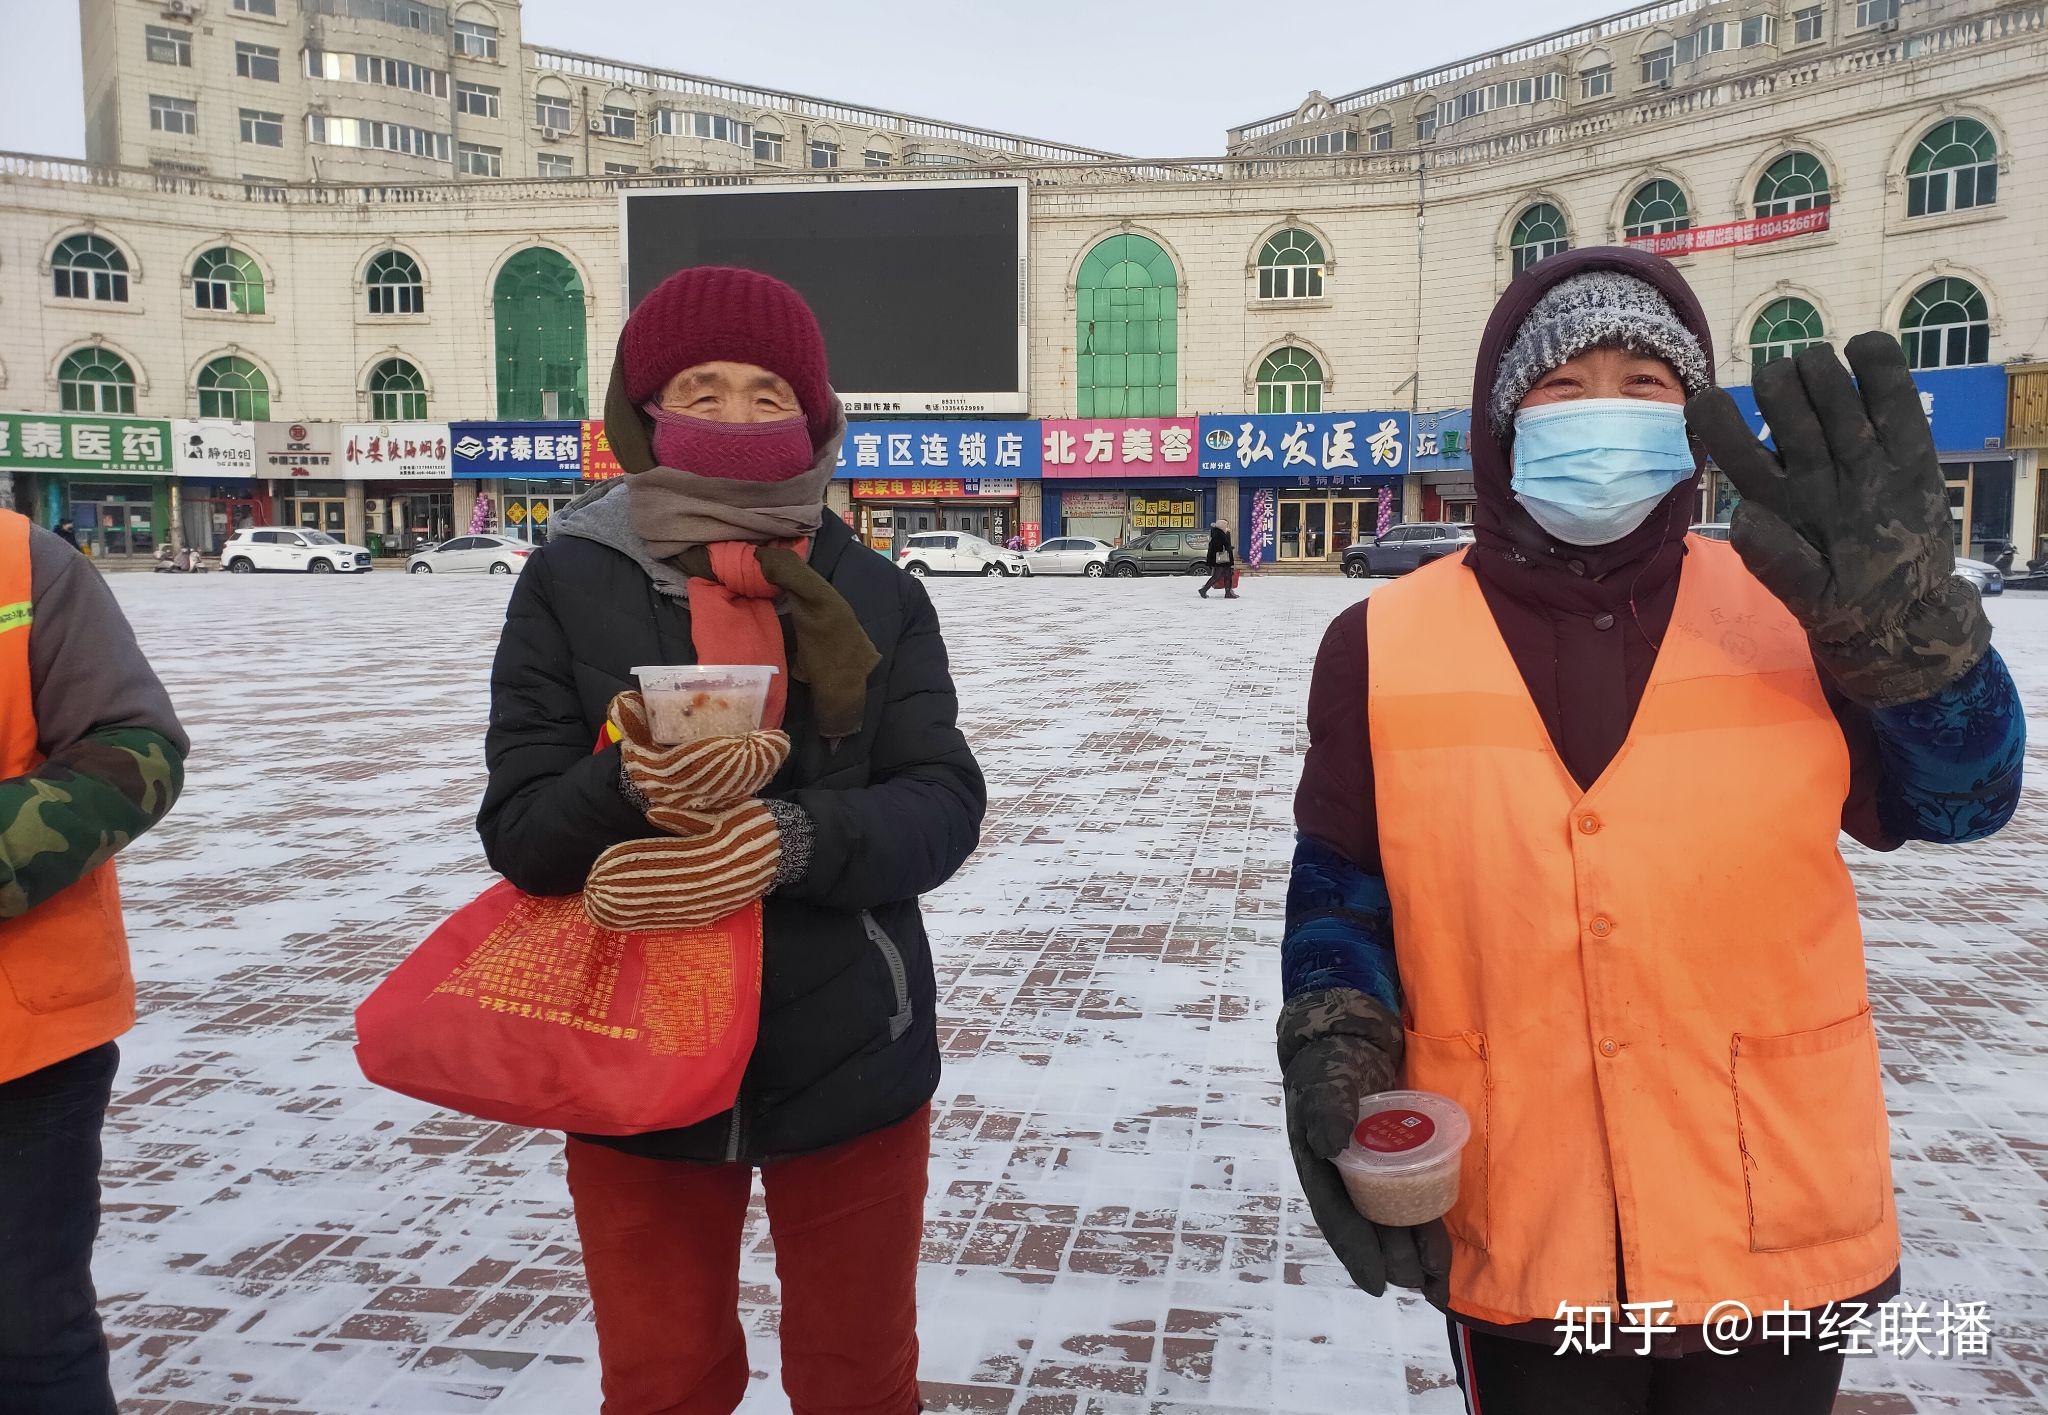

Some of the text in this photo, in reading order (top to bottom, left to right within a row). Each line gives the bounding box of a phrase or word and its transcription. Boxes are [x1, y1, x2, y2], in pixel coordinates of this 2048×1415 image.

[0, 421, 162, 462] 泰医药
[487, 435, 578, 462] 齐泰医药
[836, 432, 1022, 468] 富区连锁店
[1043, 425, 1192, 464] 北方美容
[1237, 418, 1402, 471] 弘发医药
[1415, 430, 1471, 459] 玩具
[268, 456, 330, 465] 中国工商银行
[858, 479, 960, 495] 买家电 到华丰
